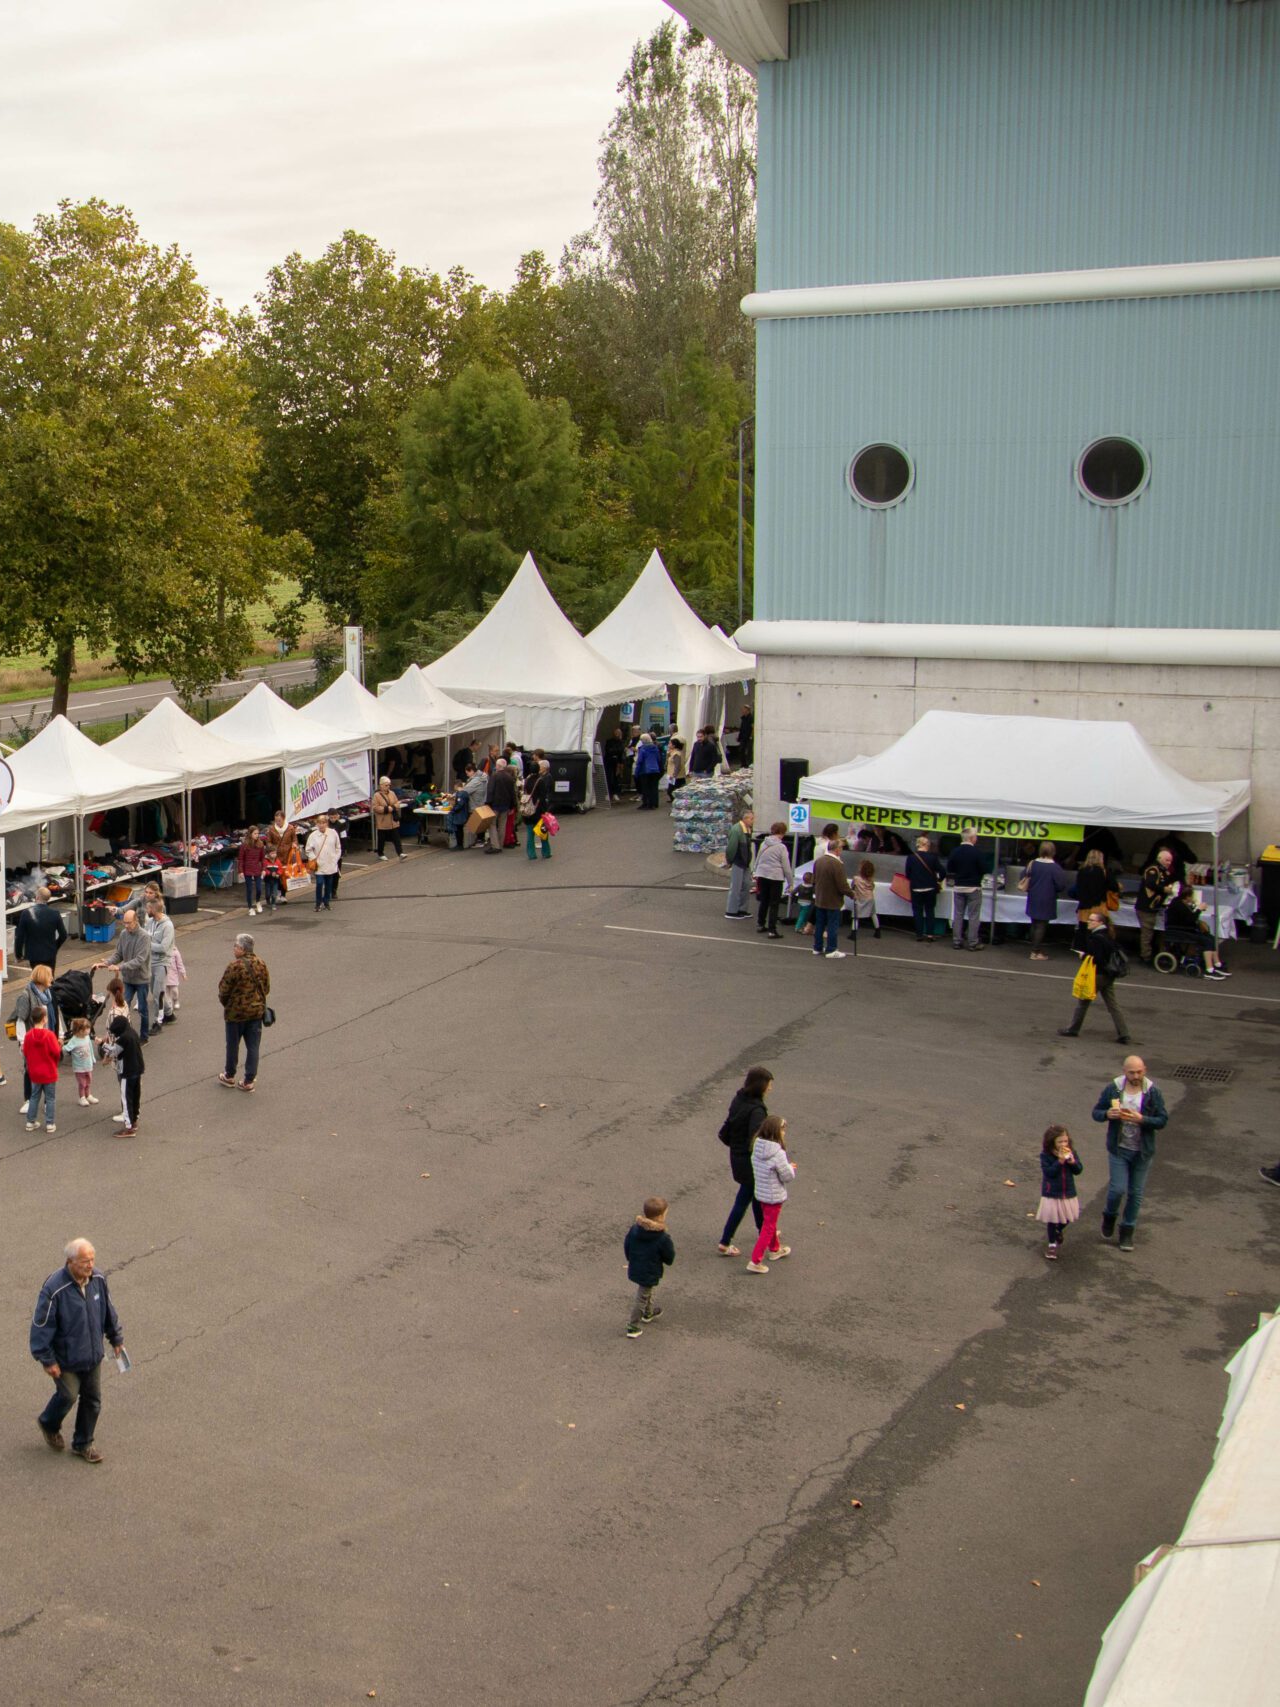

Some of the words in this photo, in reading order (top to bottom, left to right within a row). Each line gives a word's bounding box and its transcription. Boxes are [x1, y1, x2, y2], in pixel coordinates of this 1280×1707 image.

[301, 777, 328, 809] MUNDO
[792, 808, 805, 820] 21
[919, 811, 941, 829] ET
